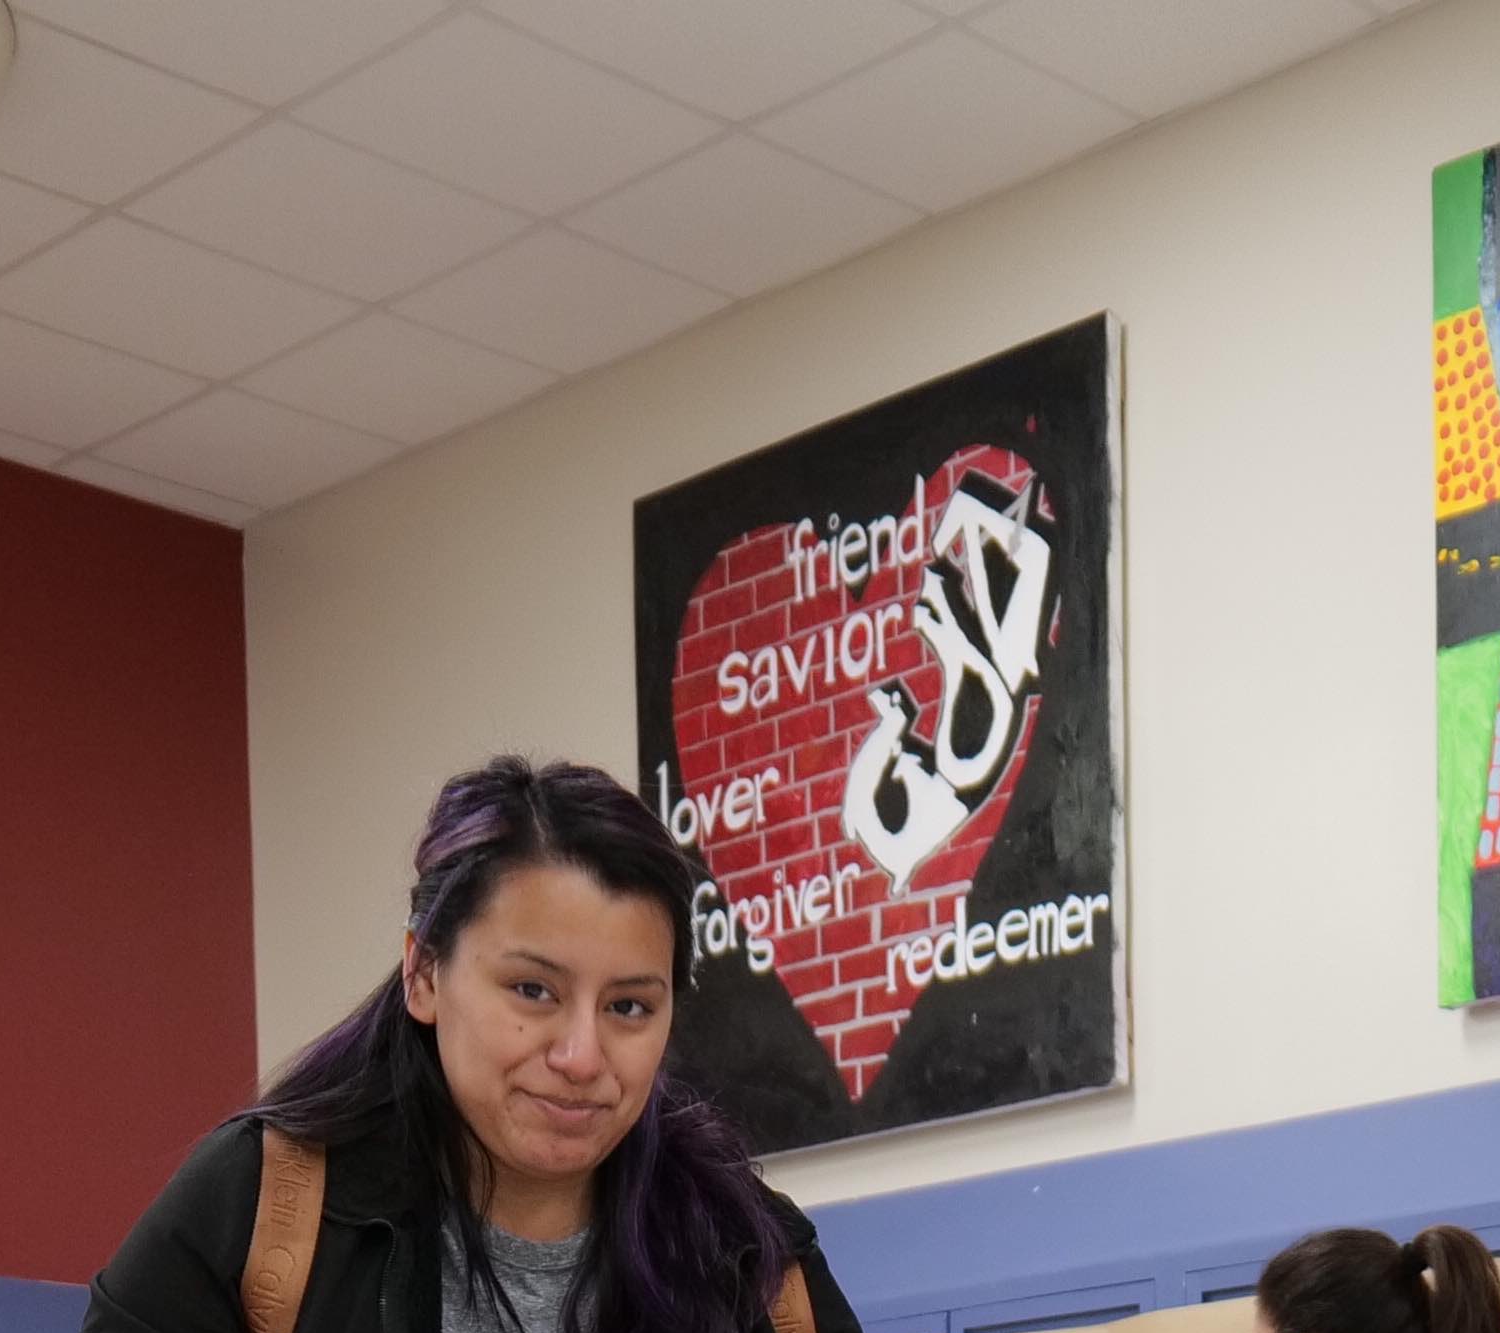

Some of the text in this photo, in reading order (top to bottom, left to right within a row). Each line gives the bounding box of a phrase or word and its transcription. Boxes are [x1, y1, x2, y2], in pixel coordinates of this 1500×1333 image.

[787, 475, 928, 602] friend
[719, 601, 904, 715] savior
[655, 760, 781, 847] lover
[691, 858, 860, 974] forgiver
[886, 892, 1110, 994] redeemer
